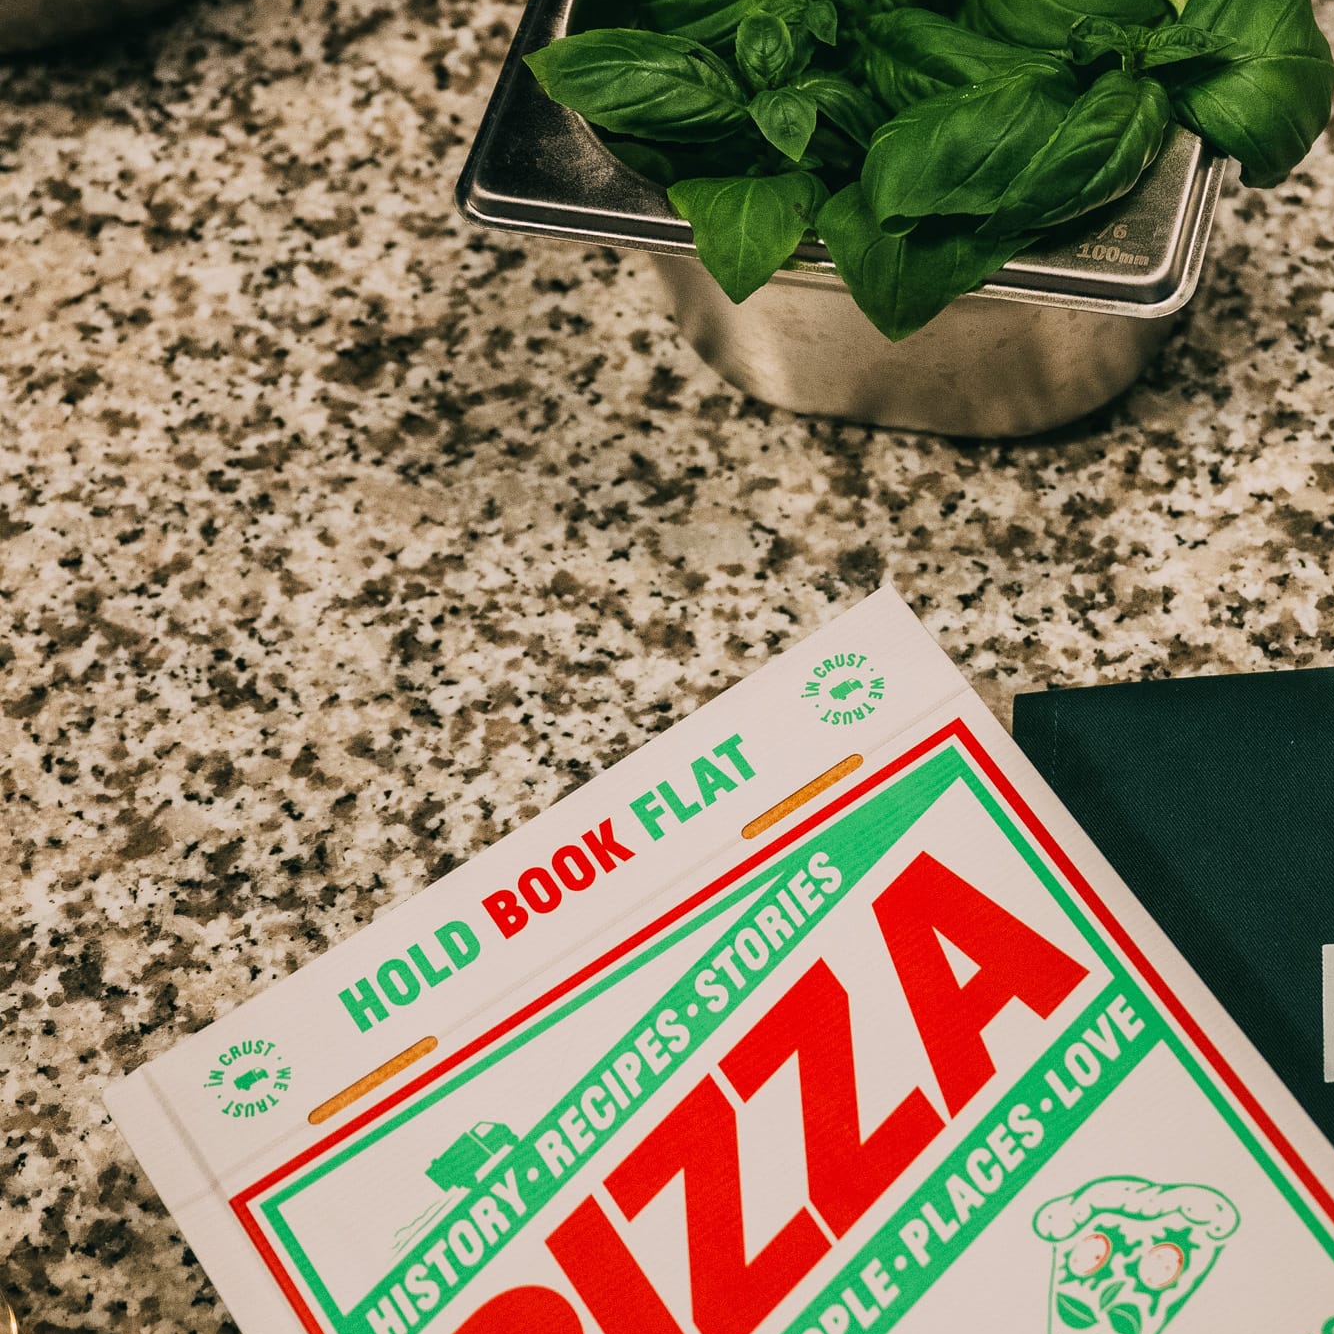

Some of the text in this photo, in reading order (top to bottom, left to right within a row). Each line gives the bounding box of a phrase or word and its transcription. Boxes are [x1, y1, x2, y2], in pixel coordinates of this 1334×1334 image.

[1076, 242, 1150, 266] 100mm
[813, 653, 867, 678] CRUST
[868, 677, 885, 699] WE
[820, 702, 875, 725] TRUST
[338, 733, 757, 1034] HOLD BOOK FLAT
[218, 1039, 276, 1066] CRUST
[273, 1067, 291, 1091] WE
[221, 1094, 279, 1117] TRUST
